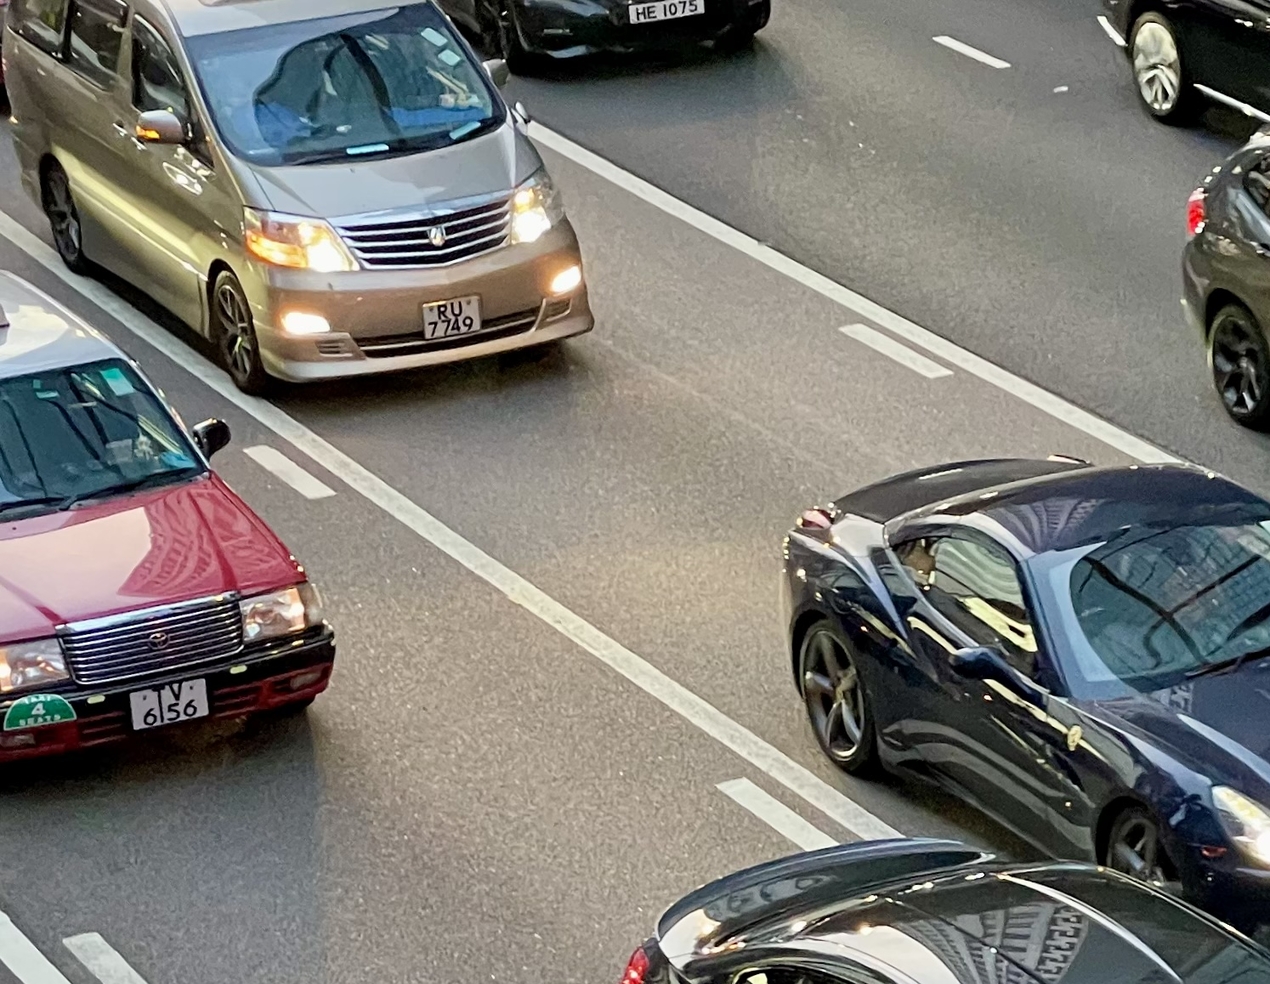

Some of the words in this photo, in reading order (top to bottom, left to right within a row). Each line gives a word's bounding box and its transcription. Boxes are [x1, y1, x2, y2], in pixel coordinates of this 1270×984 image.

[636, 6, 657, 21] HE
[663, 0, 698, 18] 1075
[437, 301, 463, 320] RU
[428, 316, 474, 338] 7749
[152, 683, 184, 706] TV
[31, 702, 46, 715] 4
[143, 699, 198, 726] 6156
